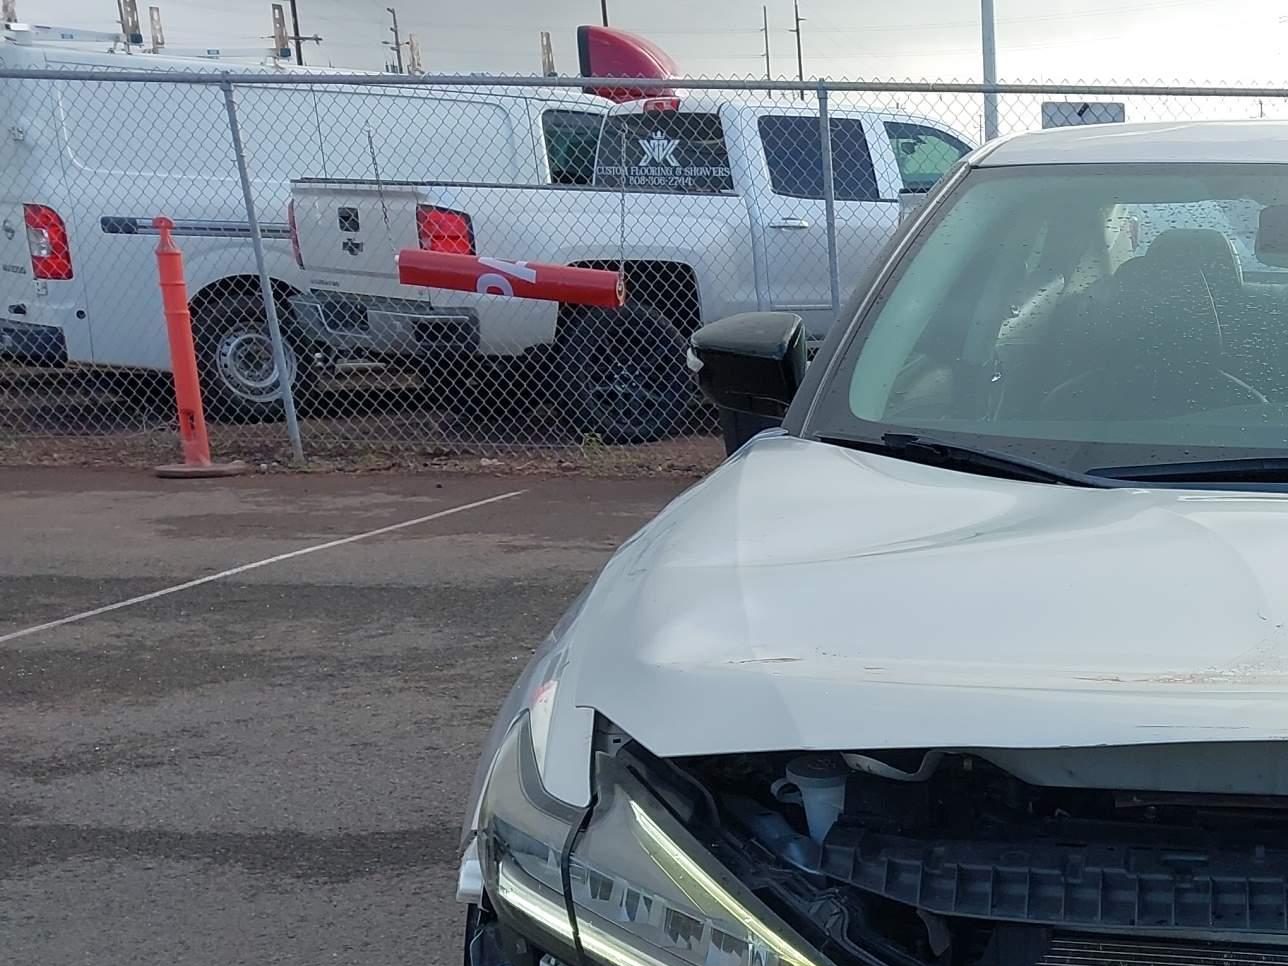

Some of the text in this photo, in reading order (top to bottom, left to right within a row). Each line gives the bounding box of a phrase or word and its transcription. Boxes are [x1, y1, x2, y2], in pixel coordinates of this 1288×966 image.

[630, 166, 673, 176] FLOORING
[675, 166, 682, 175] &
[684, 167, 731, 176] SHOWERS
